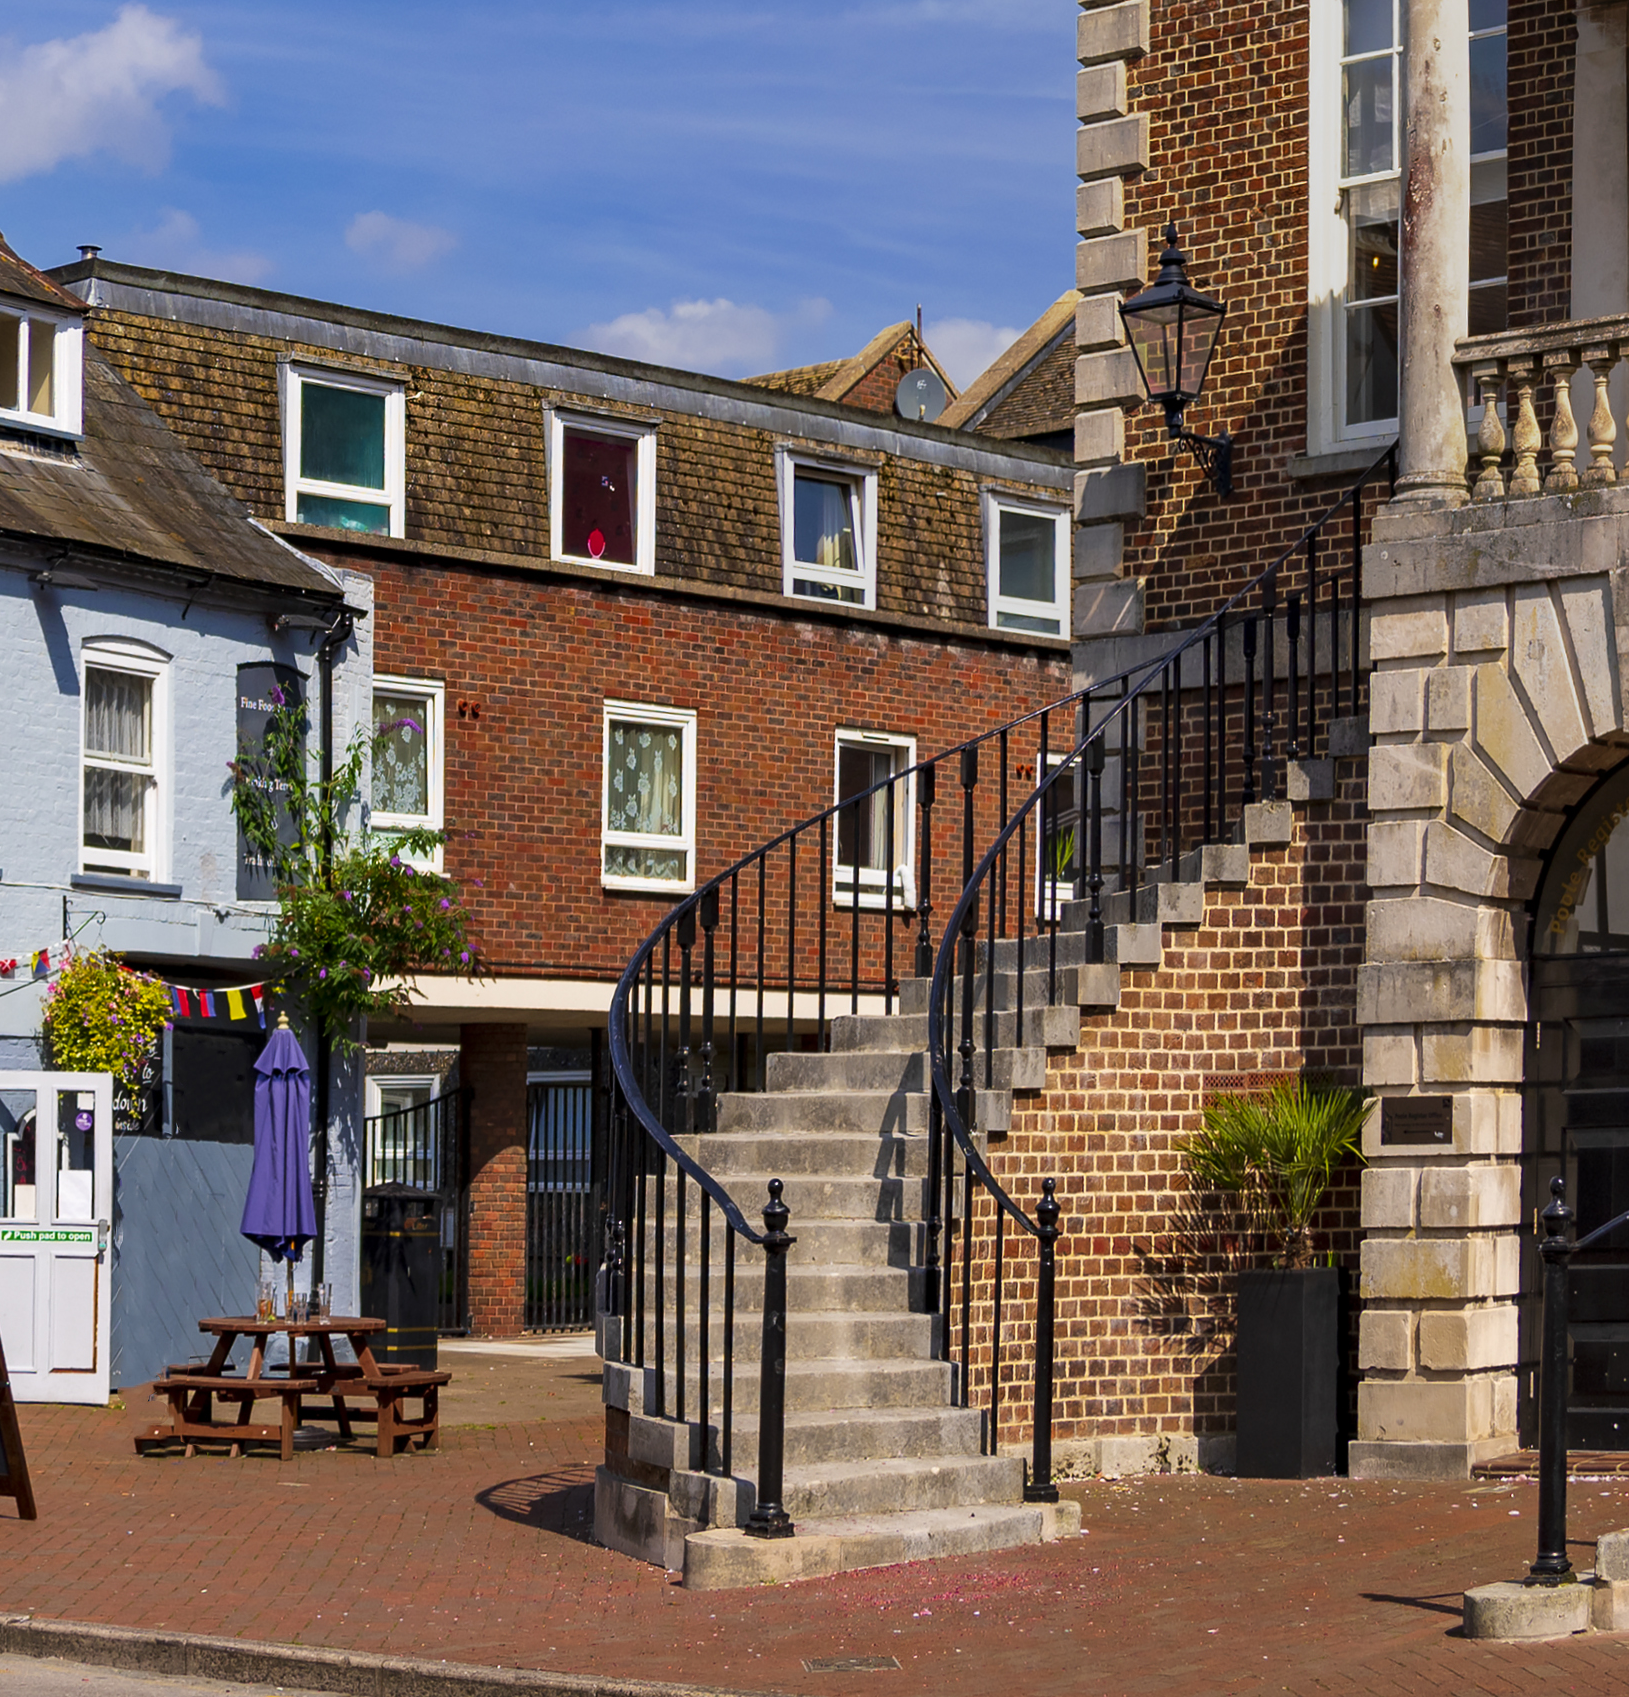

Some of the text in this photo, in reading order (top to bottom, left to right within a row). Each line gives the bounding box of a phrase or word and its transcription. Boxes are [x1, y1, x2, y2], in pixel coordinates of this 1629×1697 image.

[240, 696, 257, 710] Fine
[258, 698, 275, 713] Foo
[1550, 870, 1582, 935] Poole
[40, 1232, 55, 1240] pad
[68, 1233, 90, 1241] open
